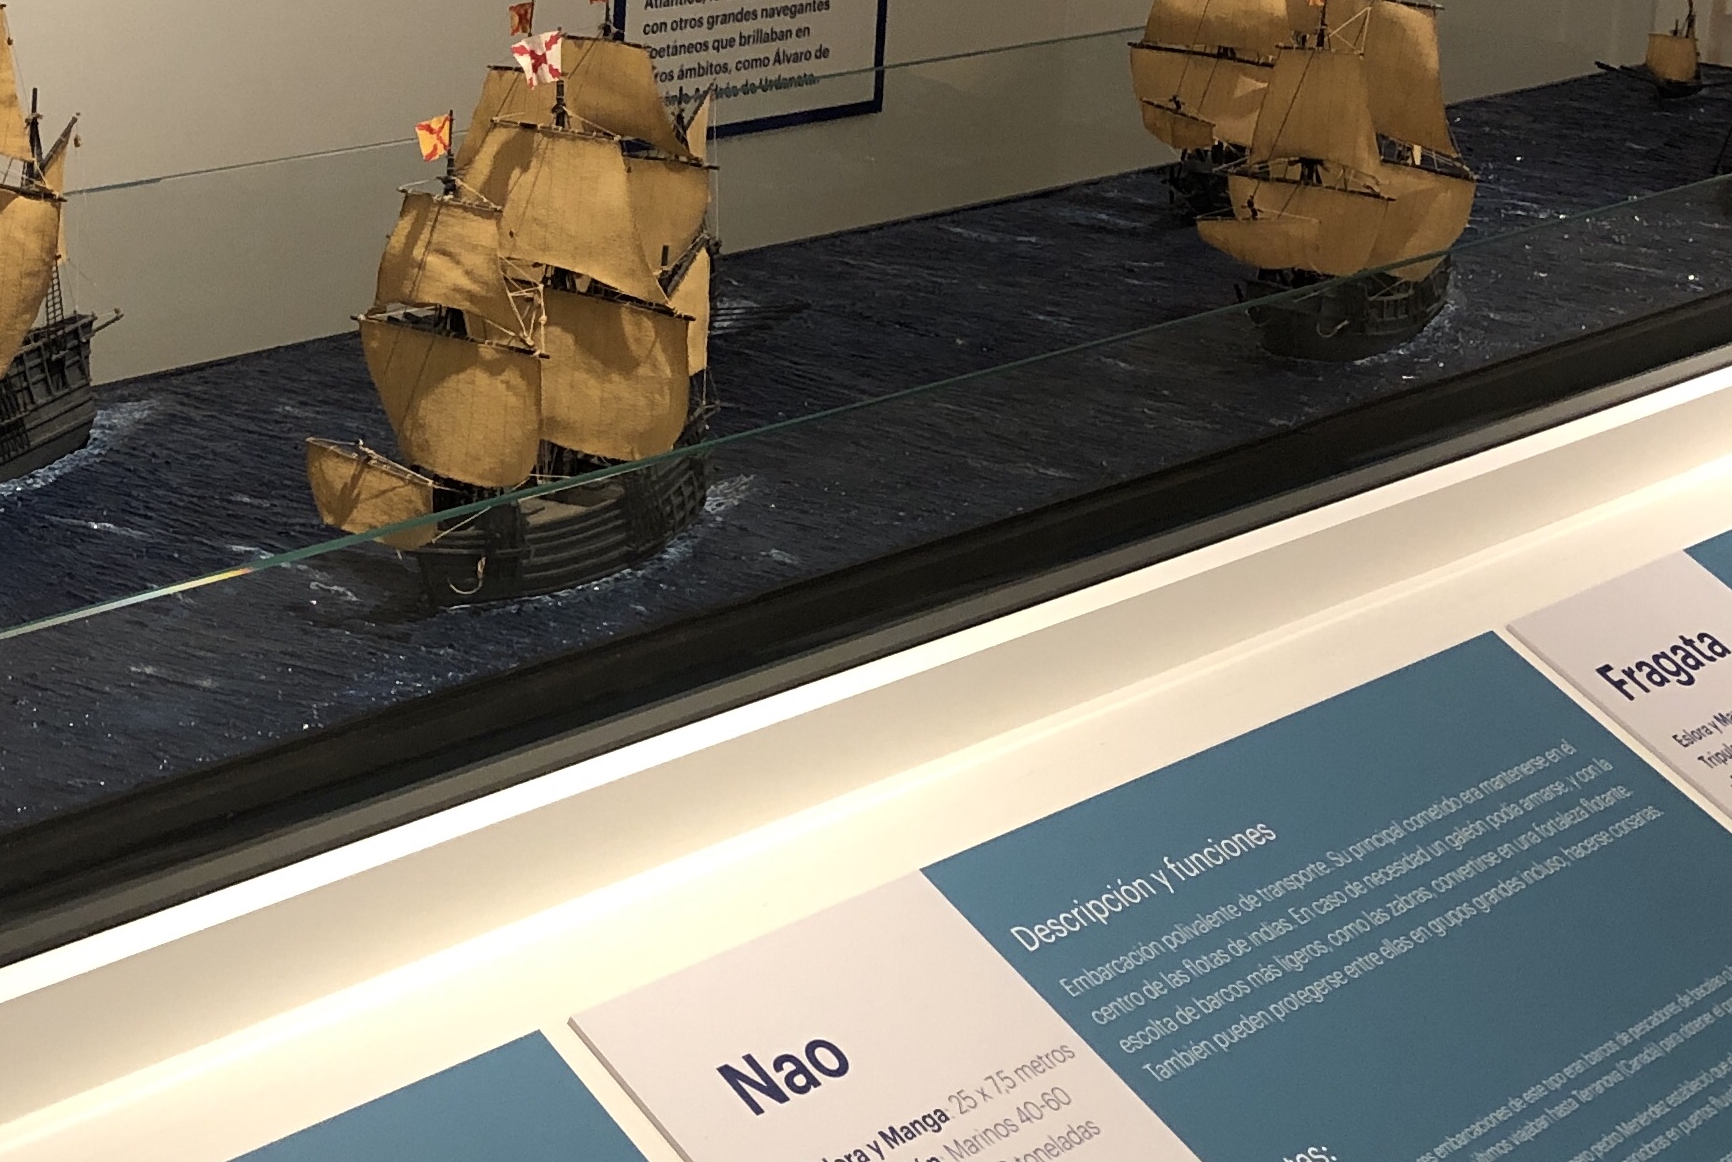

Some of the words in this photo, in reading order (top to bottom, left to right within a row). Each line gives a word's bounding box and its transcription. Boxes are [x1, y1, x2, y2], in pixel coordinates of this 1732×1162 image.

[642, 21, 668, 36] con
[670, 16, 704, 32] otros
[706, 6, 758, 31] grandes
[760, 0, 831, 20] navegantes
[1595, 631, 1732, 701] Fragata
[1671, 725, 1713, 748] Eslora
[1708, 720, 1723, 734] y
[1010, 878, 1157, 952] Descripción
[1149, 869, 1175, 894] y
[1163, 823, 1277, 881] funciones
[1058, 941, 1167, 997] Embarcación
[1160, 904, 1242, 951] polivalente
[1238, 893, 1262, 912] de
[1255, 861, 1335, 902] transporte.
[1325, 850, 1353, 867] Su
[1347, 820, 1407, 862] principal
[1402, 796, 1463, 832] cometido
[1459, 787, 1484, 804] era
[1478, 755, 1550, 795] mantenerse
[1544, 748, 1565, 763] en
[1560, 738, 1577, 755] el
[1141, 1040, 1219, 1082] También
[1211, 1010, 1274, 1050] pueden
[1268, 970, 1349, 1021] protegerse
[1343, 952, 1384, 979] entre
[1379, 935, 1414, 960] ellas
[1409, 926, 1433, 944] en
[1427, 902, 1477, 937] grupos
[1471, 876, 1527, 914] grandes
[1560, 830, 1614, 861] hacerse
[716, 1038, 850, 1116] Nao
[867, 1140, 886, 1161] y
[948, 1089, 978, 1115] 25
[976, 1088, 994, 1102] x
[1014, 1044, 1076, 1083] metros
[943, 1118, 1019, 1162] Marinos
[1016, 1086, 1072, 1124] 40-60
